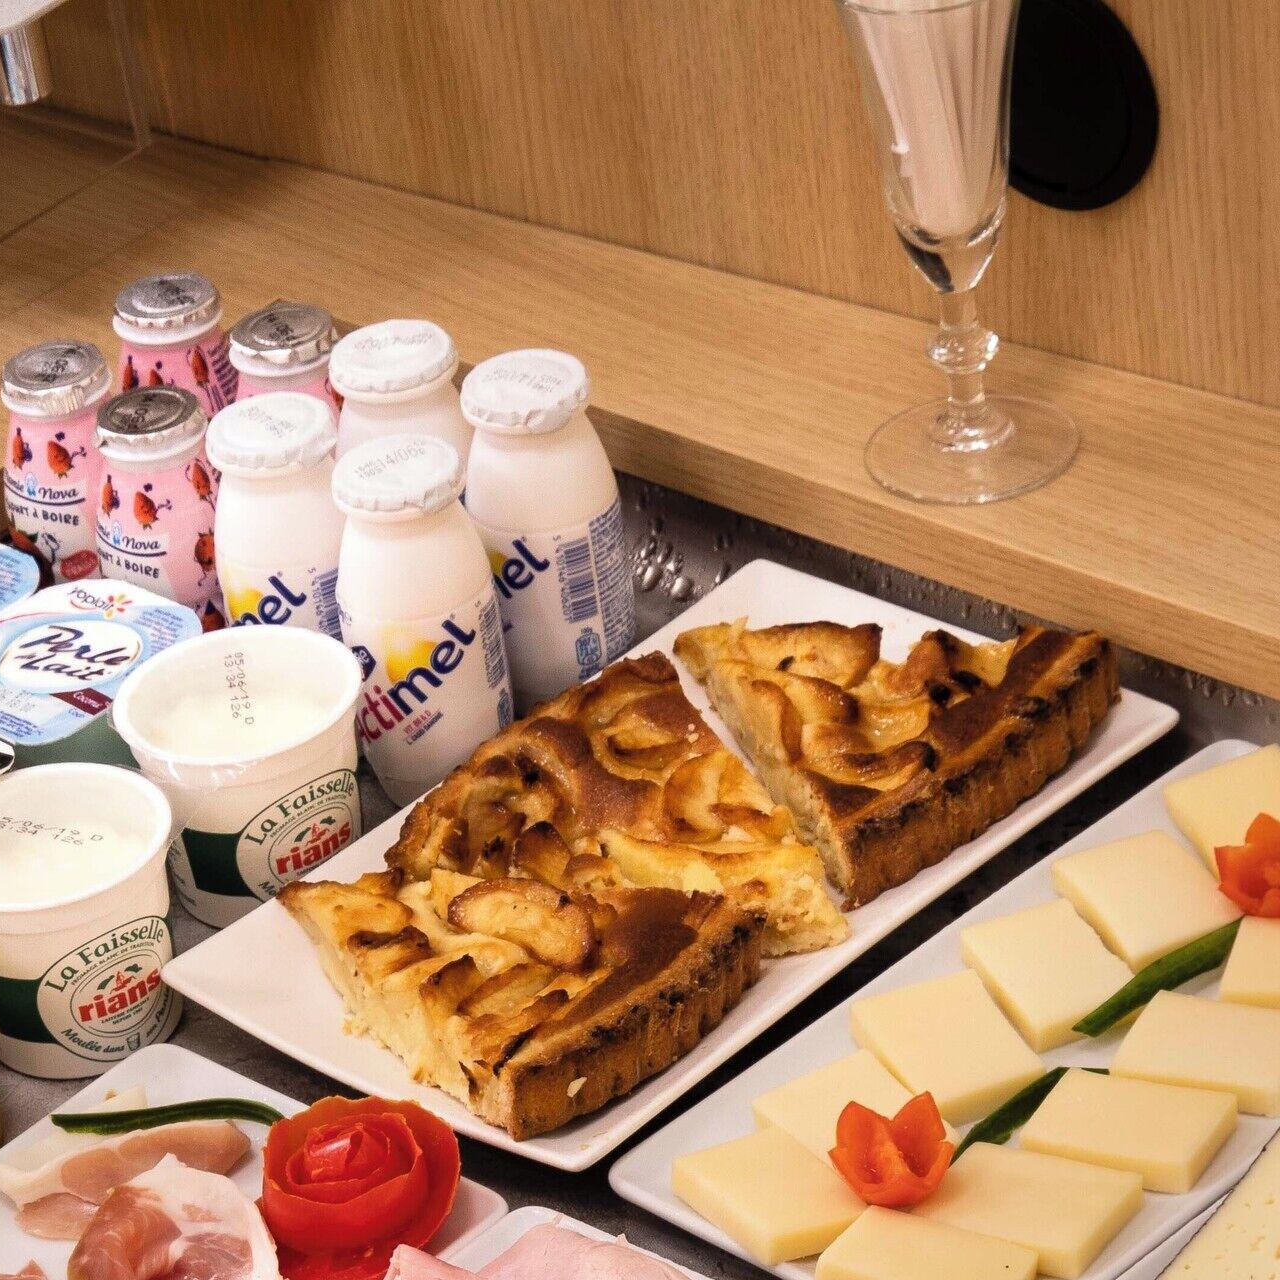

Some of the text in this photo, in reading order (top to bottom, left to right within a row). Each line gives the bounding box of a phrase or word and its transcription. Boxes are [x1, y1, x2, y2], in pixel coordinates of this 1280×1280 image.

[38, 487, 80, 500] Nova
[42, 511, 80, 526] BOIRE
[122, 535, 161, 550] Nova
[124, 561, 160, 579] BOIRE
[20, 625, 130, 666] Perle
[20, 654, 106, 681] Lait
[234, 651, 252, 710] 05/06/19
[230, 696, 242, 718] 126
[245, 772, 354, 846] La Faisselle
[53, 833, 84, 846] 126
[275, 821, 351, 876] rians
[44, 919, 164, 993] La Faisselle
[78, 968, 161, 1023] rians
